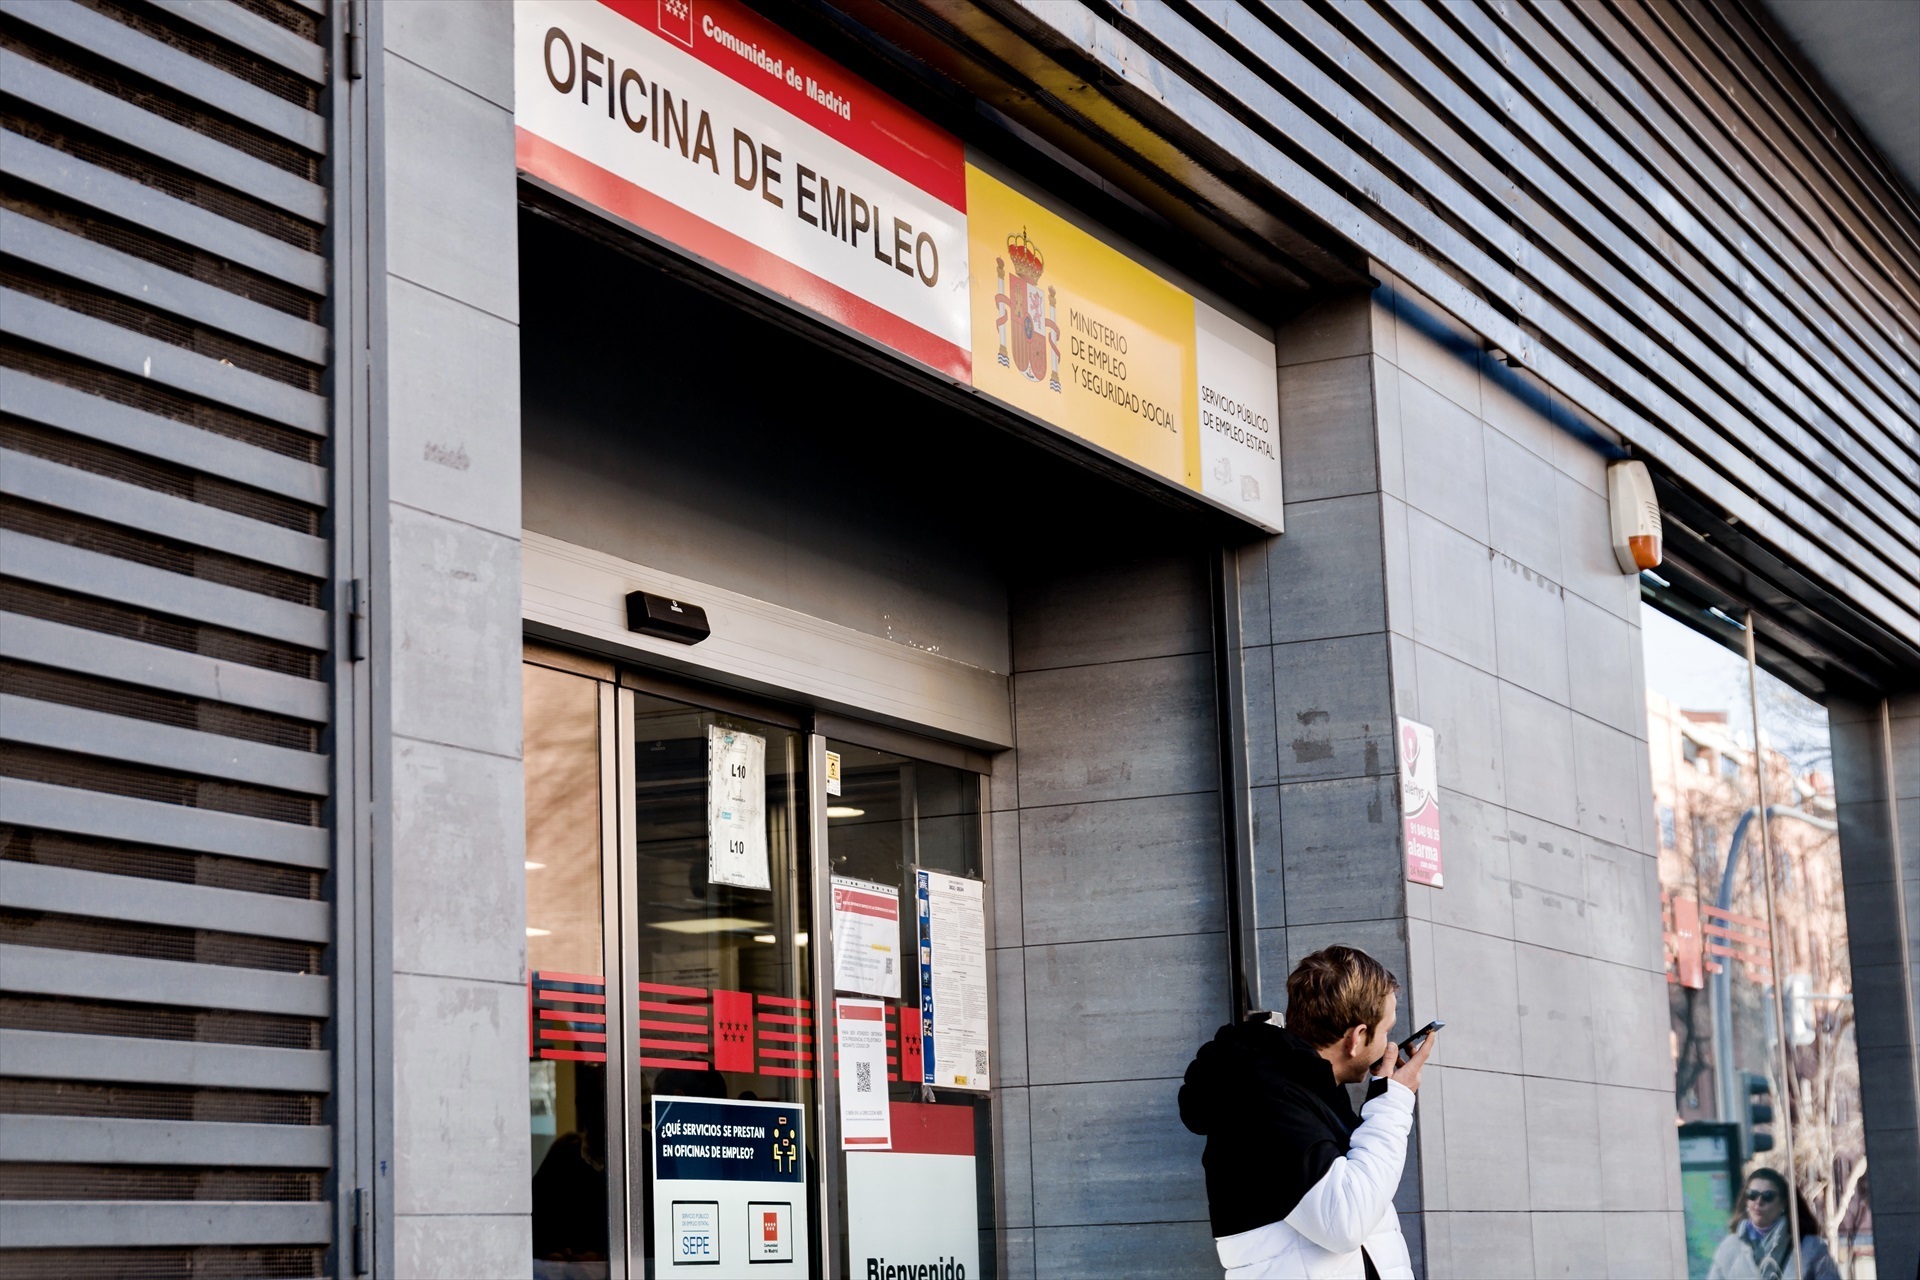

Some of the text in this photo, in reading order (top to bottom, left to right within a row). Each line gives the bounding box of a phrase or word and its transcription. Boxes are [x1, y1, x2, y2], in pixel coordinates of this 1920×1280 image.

[702, 14, 851, 120] Comunidad de Madrid
[543, 26, 940, 288] OFICINA DE EMPLEO
[1070, 308, 1127, 355] MINISTERIO
[1071, 336, 1127, 381] DE EMPLEO
[1071, 363, 1177, 433] Y SEGURIDAD SOCIAL
[1201, 385, 1269, 433] SERVICIO PÚBLICO
[1203, 410, 1275, 460] DE EMPLEO ESTATAL
[731, 763, 746, 779] L10
[729, 839, 744, 855] L10
[1408, 838, 1438, 862] alarma
[661, 1119, 765, 1139] ¿QUÉ SERVICIOS SE PRESTAN
[662, 1144, 755, 1160] EN OFICINAS DE EMPLEO?
[682, 1236, 710, 1255] SEPE
[867, 1256, 966, 1280] Bienvenido
